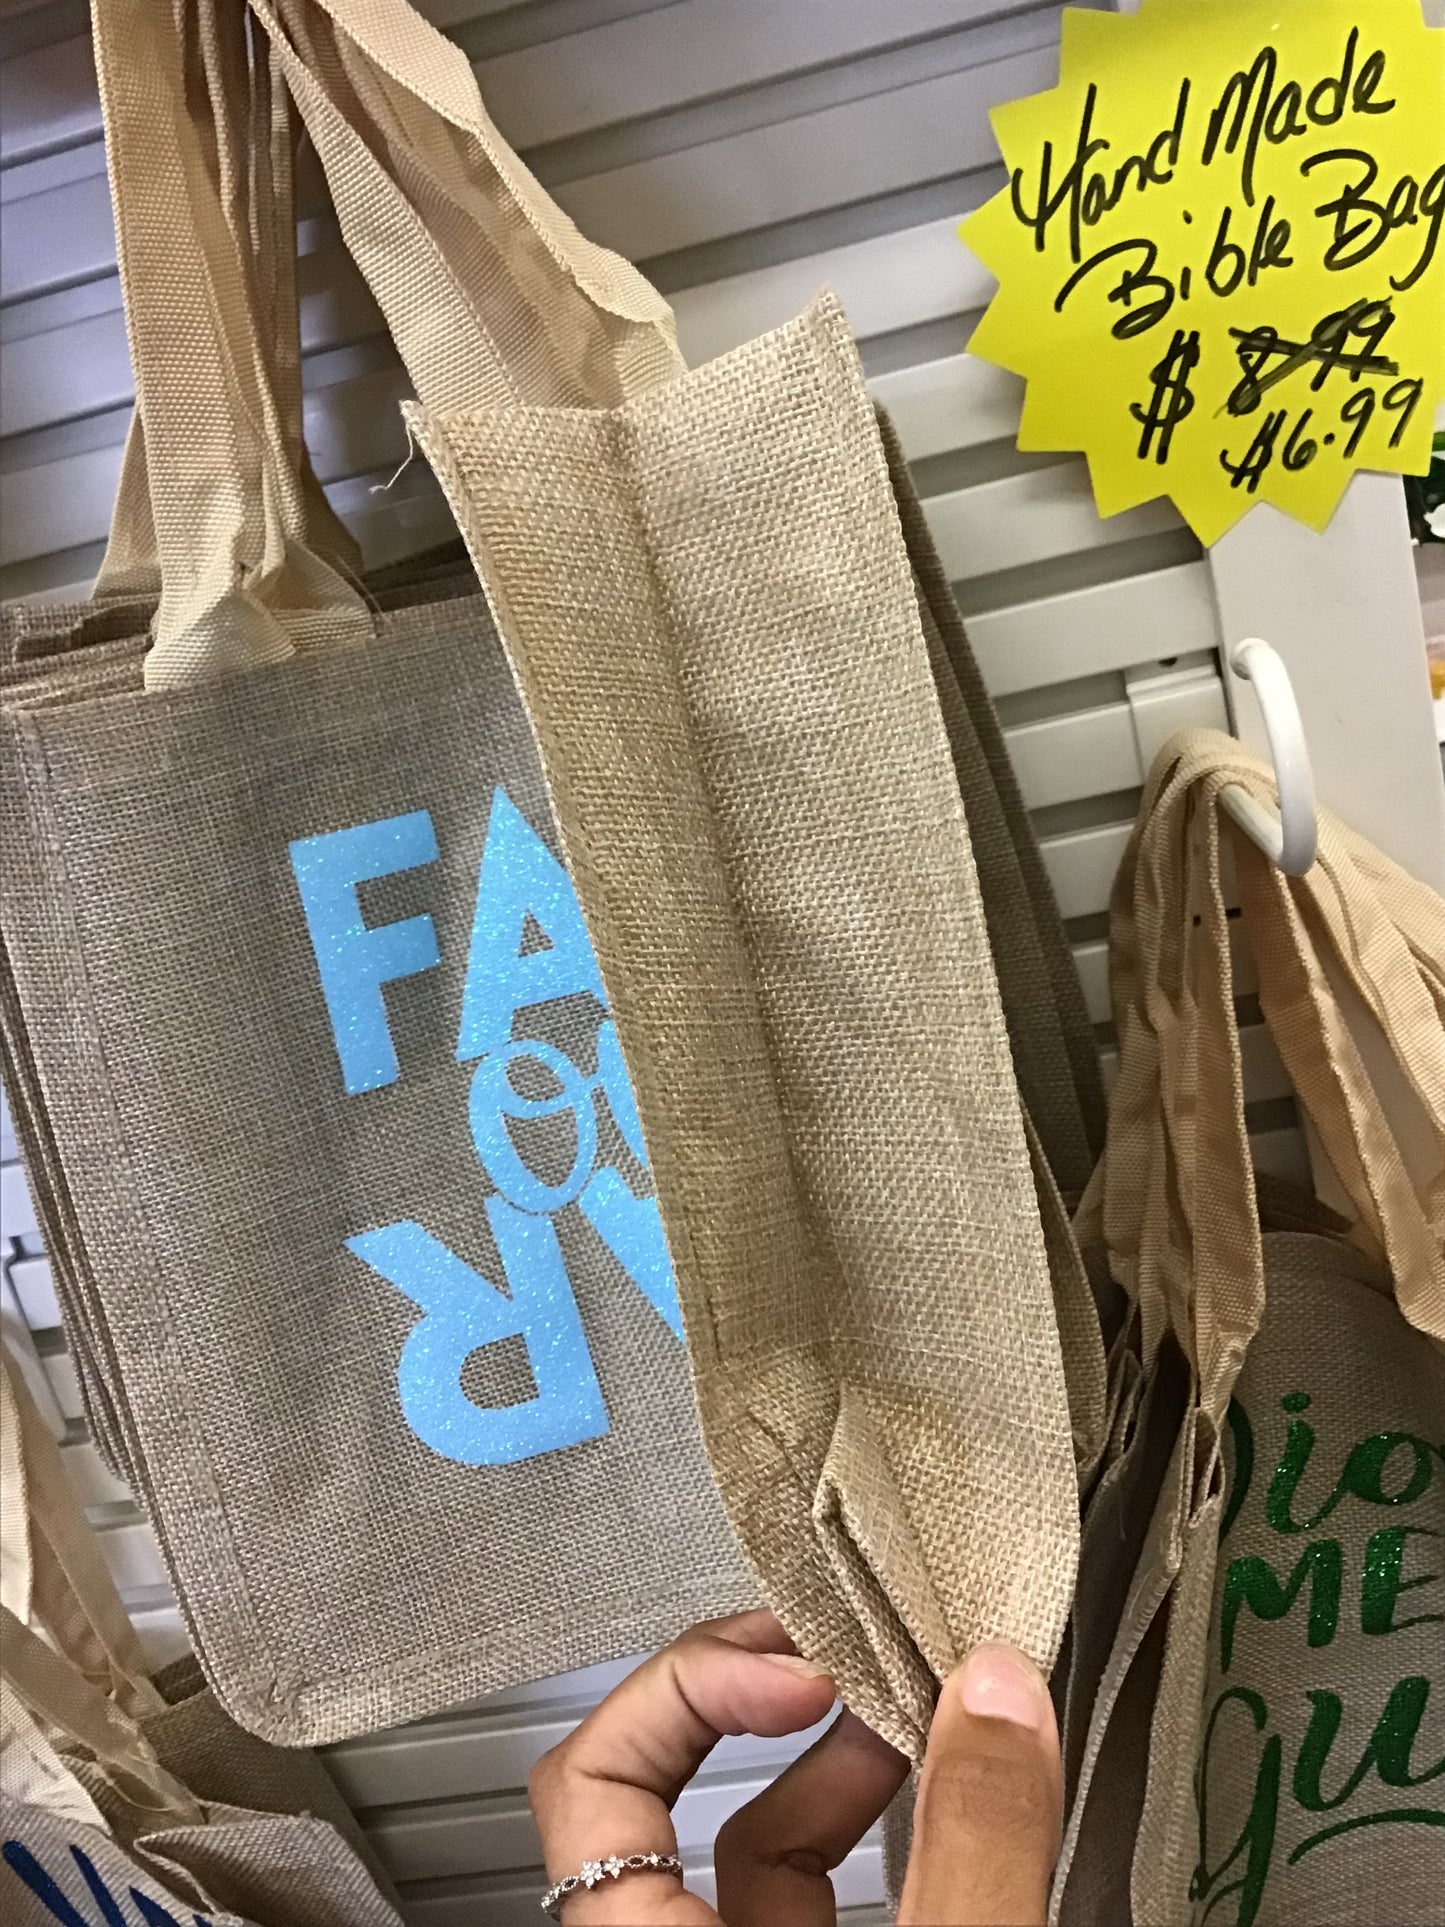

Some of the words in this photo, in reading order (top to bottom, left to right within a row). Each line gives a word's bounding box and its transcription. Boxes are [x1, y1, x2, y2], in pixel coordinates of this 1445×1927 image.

[1010, 78, 1191, 263] Hand
[1201, 26, 1396, 207] Made
[1054, 196, 1293, 340] Bible
[1300, 148, 1445, 291] Bag
[1219, 377, 1424, 494] $6.99
